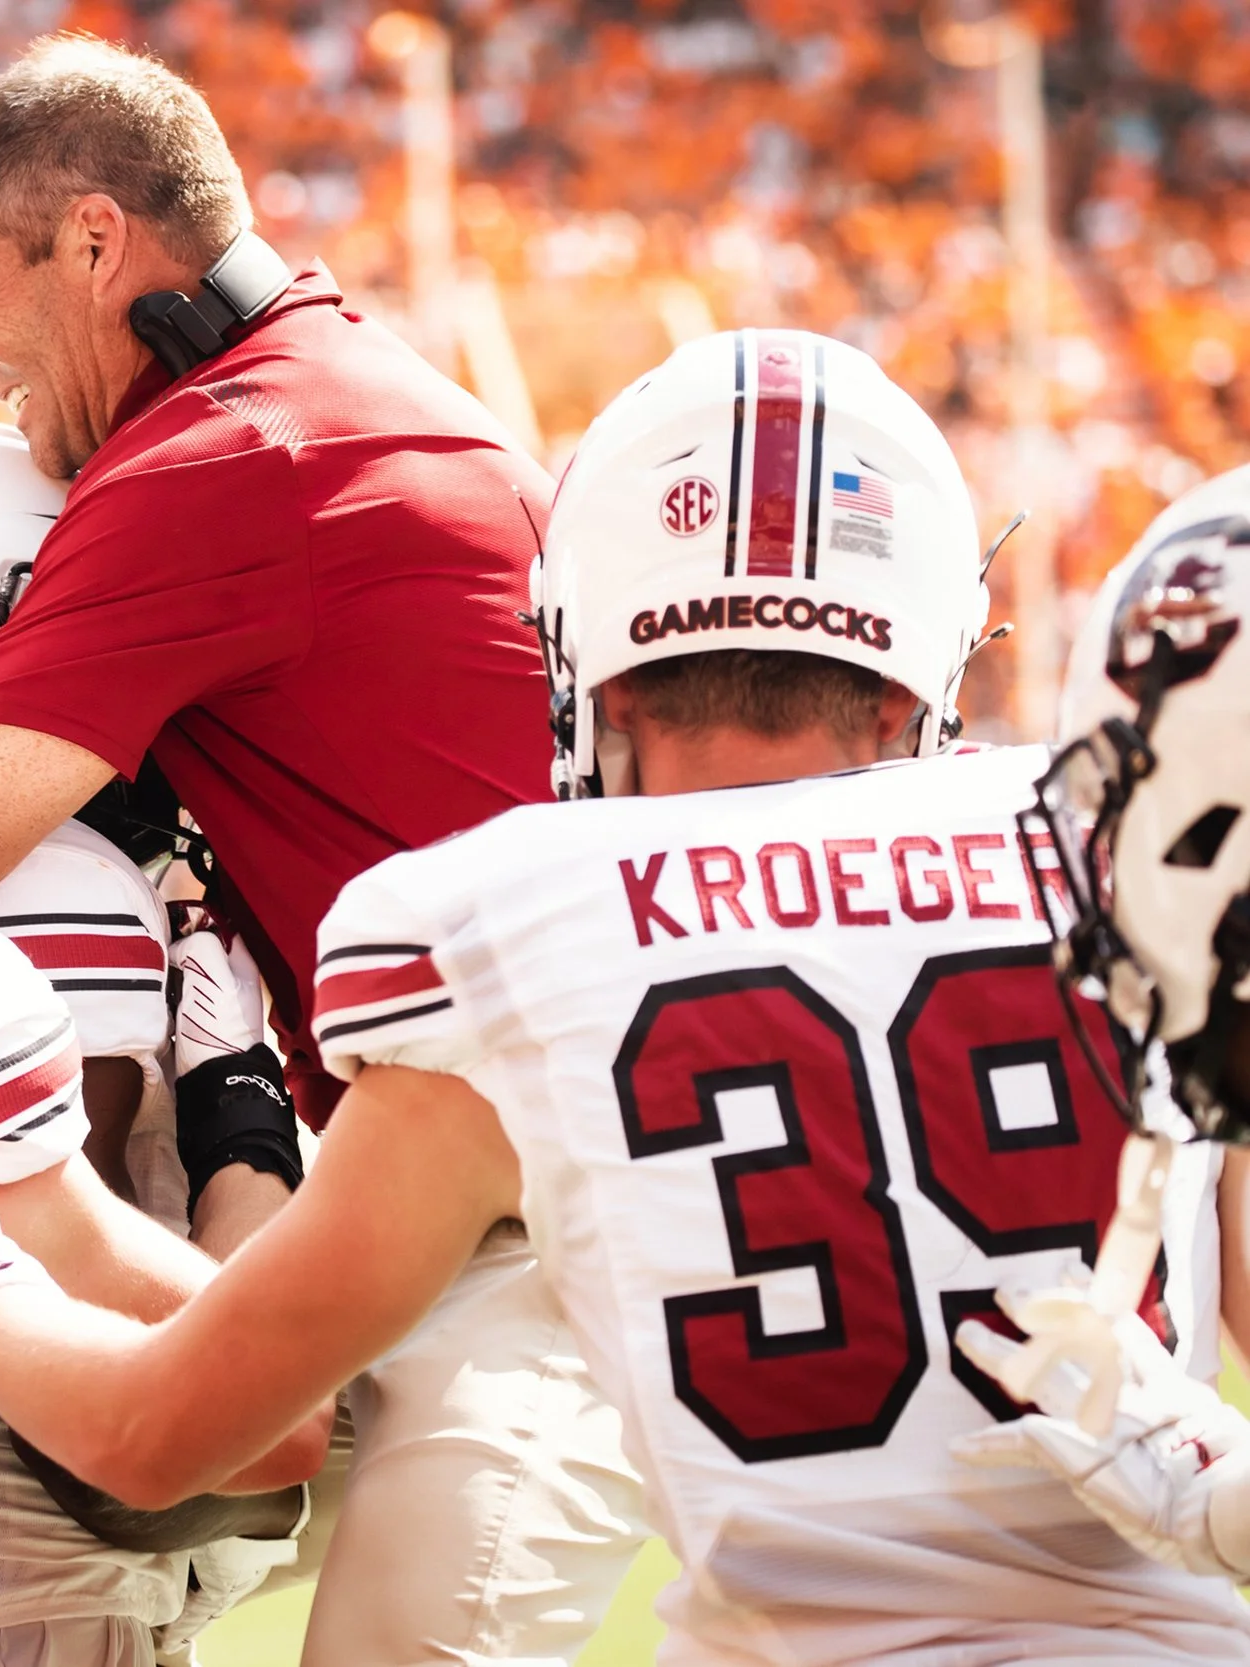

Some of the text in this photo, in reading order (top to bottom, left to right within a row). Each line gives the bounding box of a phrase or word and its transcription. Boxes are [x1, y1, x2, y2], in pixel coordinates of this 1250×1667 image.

[665, 480, 713, 532] SEC
[629, 594, 893, 651] GAMECOCKS
[613, 940, 1182, 1464] 39
